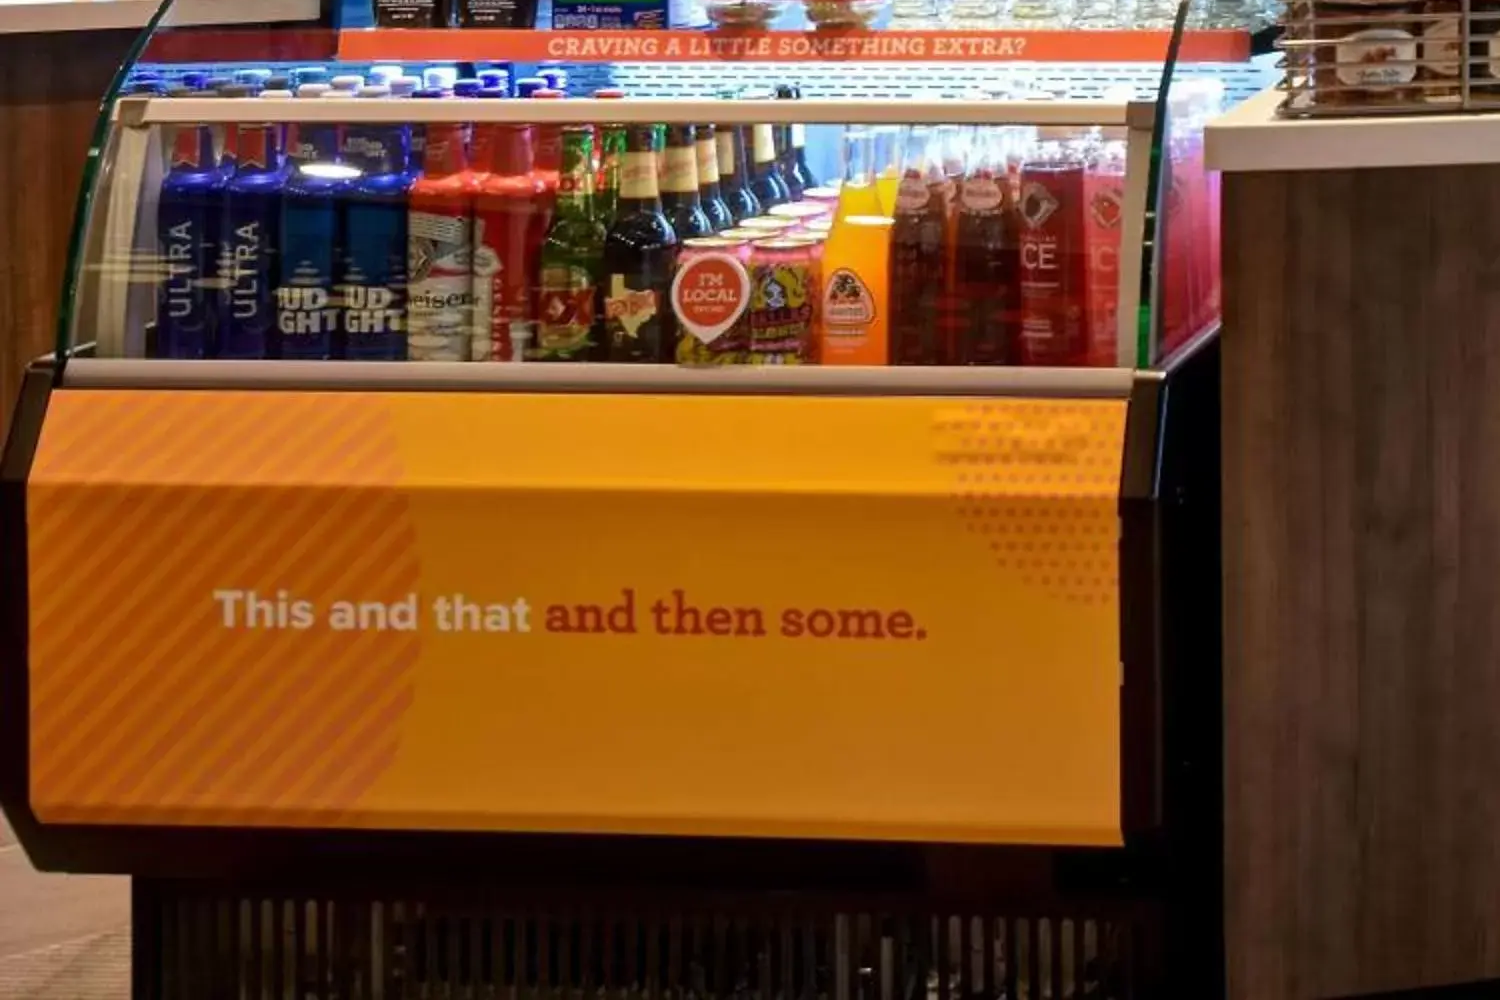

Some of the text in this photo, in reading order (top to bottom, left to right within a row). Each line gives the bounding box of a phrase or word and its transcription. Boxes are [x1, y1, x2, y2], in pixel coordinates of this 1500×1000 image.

[548, 37, 1027, 56] CRAVING A LITTLE SOMETHING EXTRA?
[1022, 243, 1058, 269] CE
[168, 220, 192, 318] ULTRA
[234, 221, 260, 319] ULTRA
[698, 272, 724, 288] I'M
[344, 286, 393, 310] UD
[683, 288, 736, 303] LOCAL
[279, 308, 341, 333] GHT
[345, 308, 405, 333] GHT
[213, 587, 928, 641] This and that and then some.
